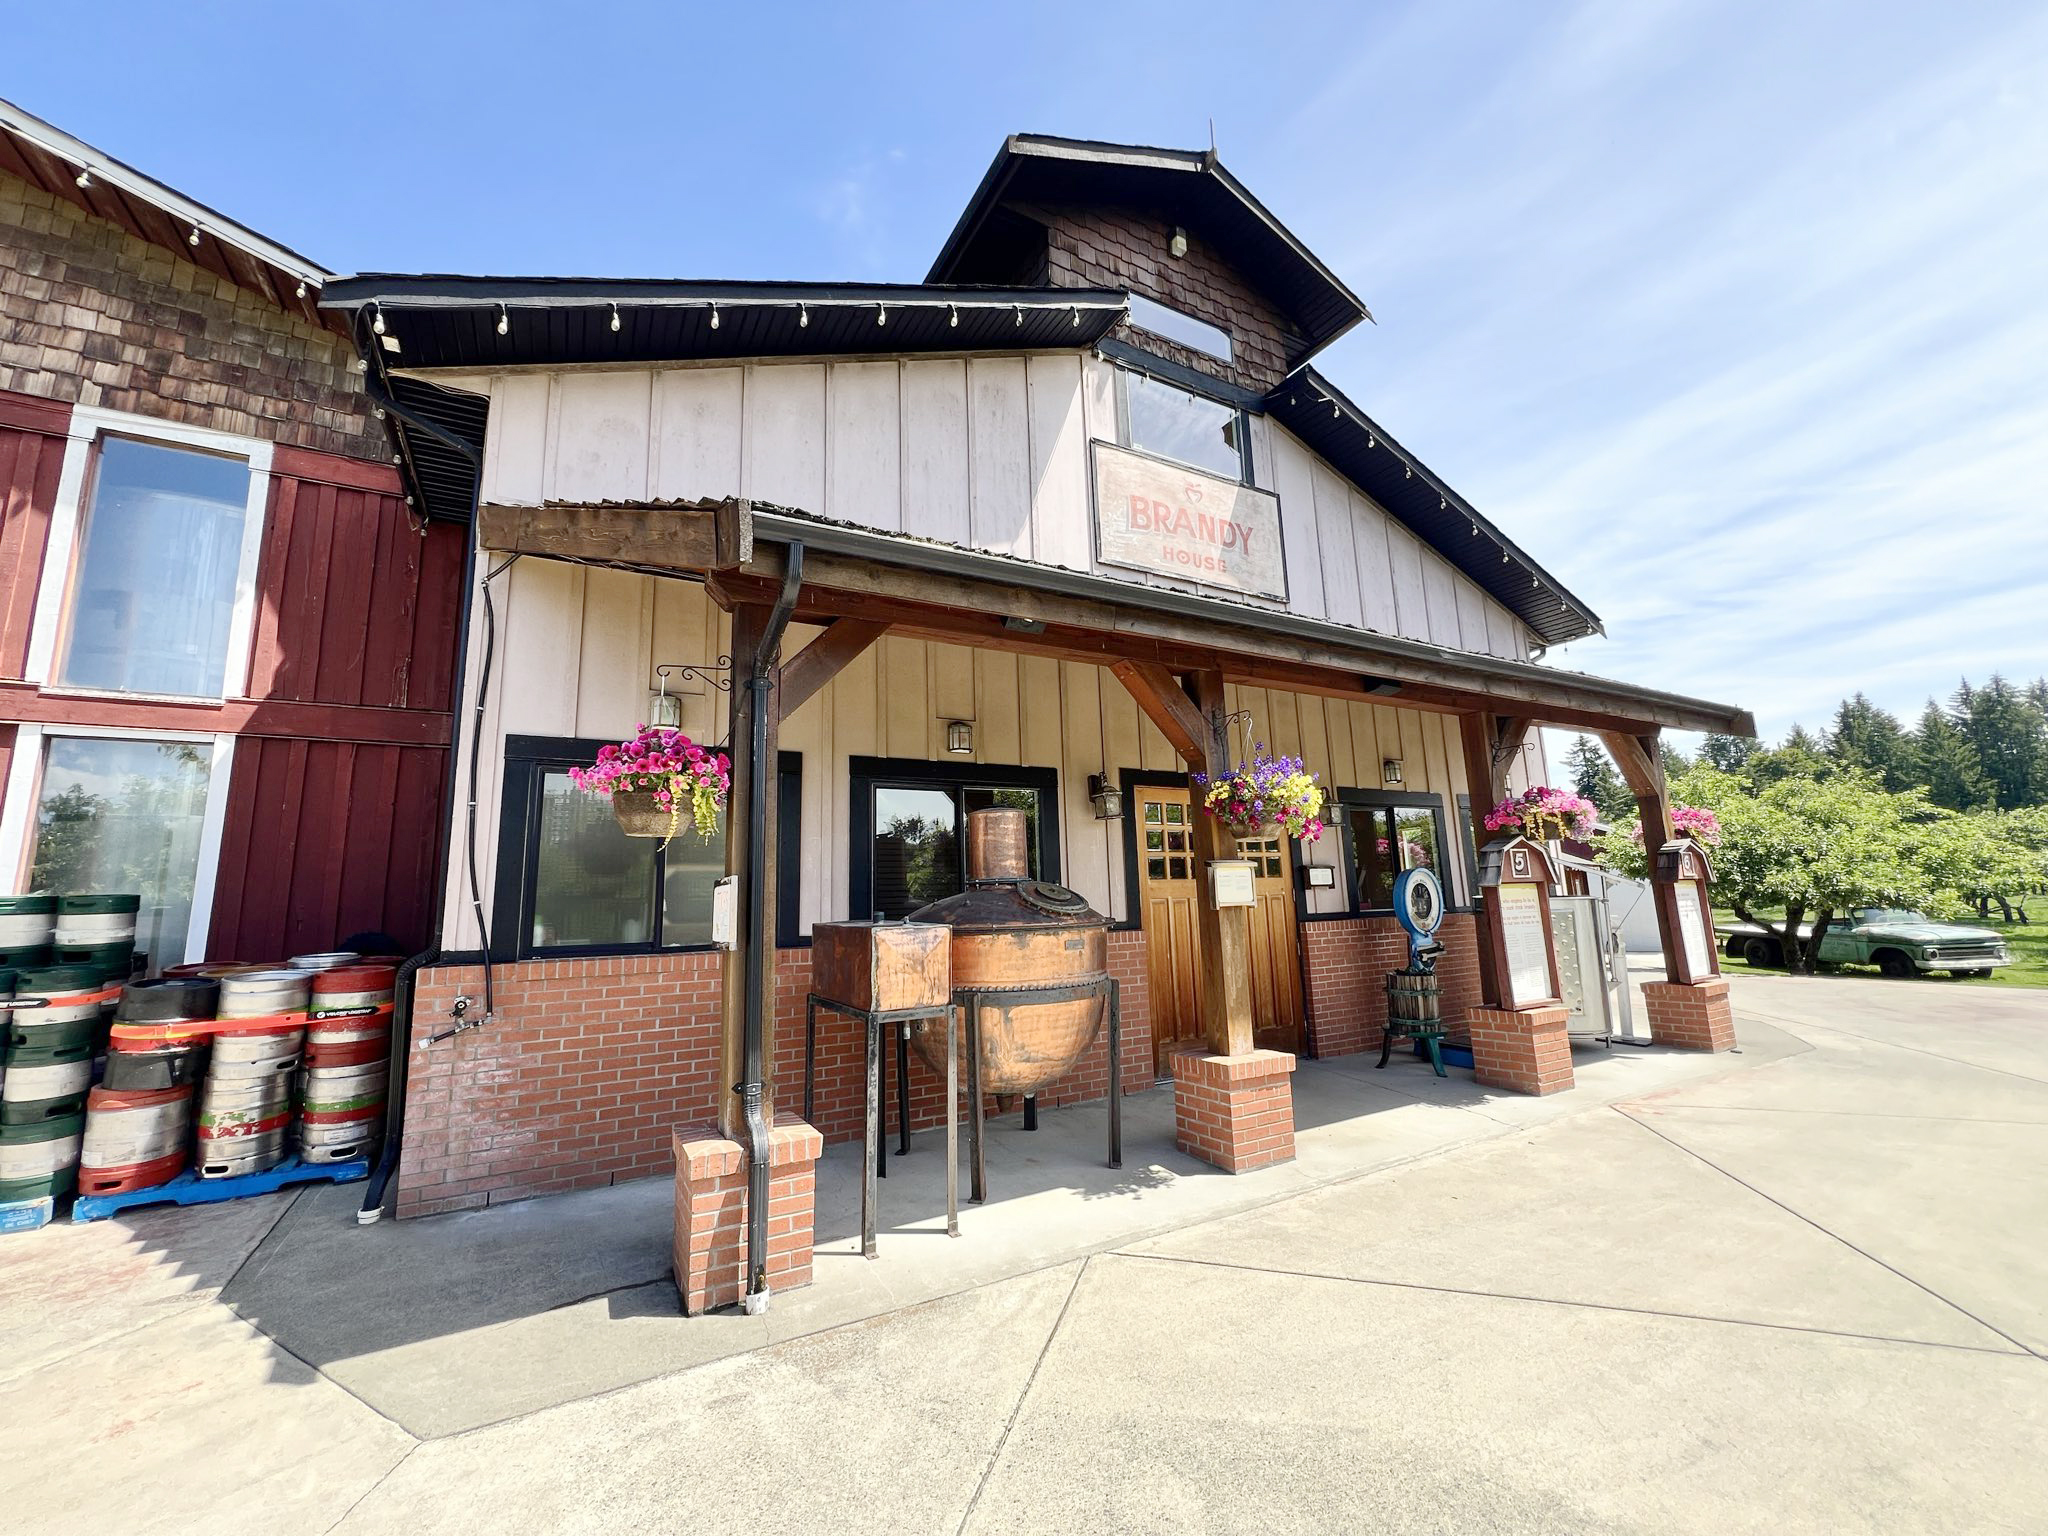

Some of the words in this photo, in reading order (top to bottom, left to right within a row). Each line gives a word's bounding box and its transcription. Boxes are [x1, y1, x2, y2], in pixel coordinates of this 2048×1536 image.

[1129, 494, 1254, 556] BRANDY
[1162, 545, 1228, 573] HOUSE
[1515, 852, 1525, 871] 5
[1684, 855, 1691, 870] 6
